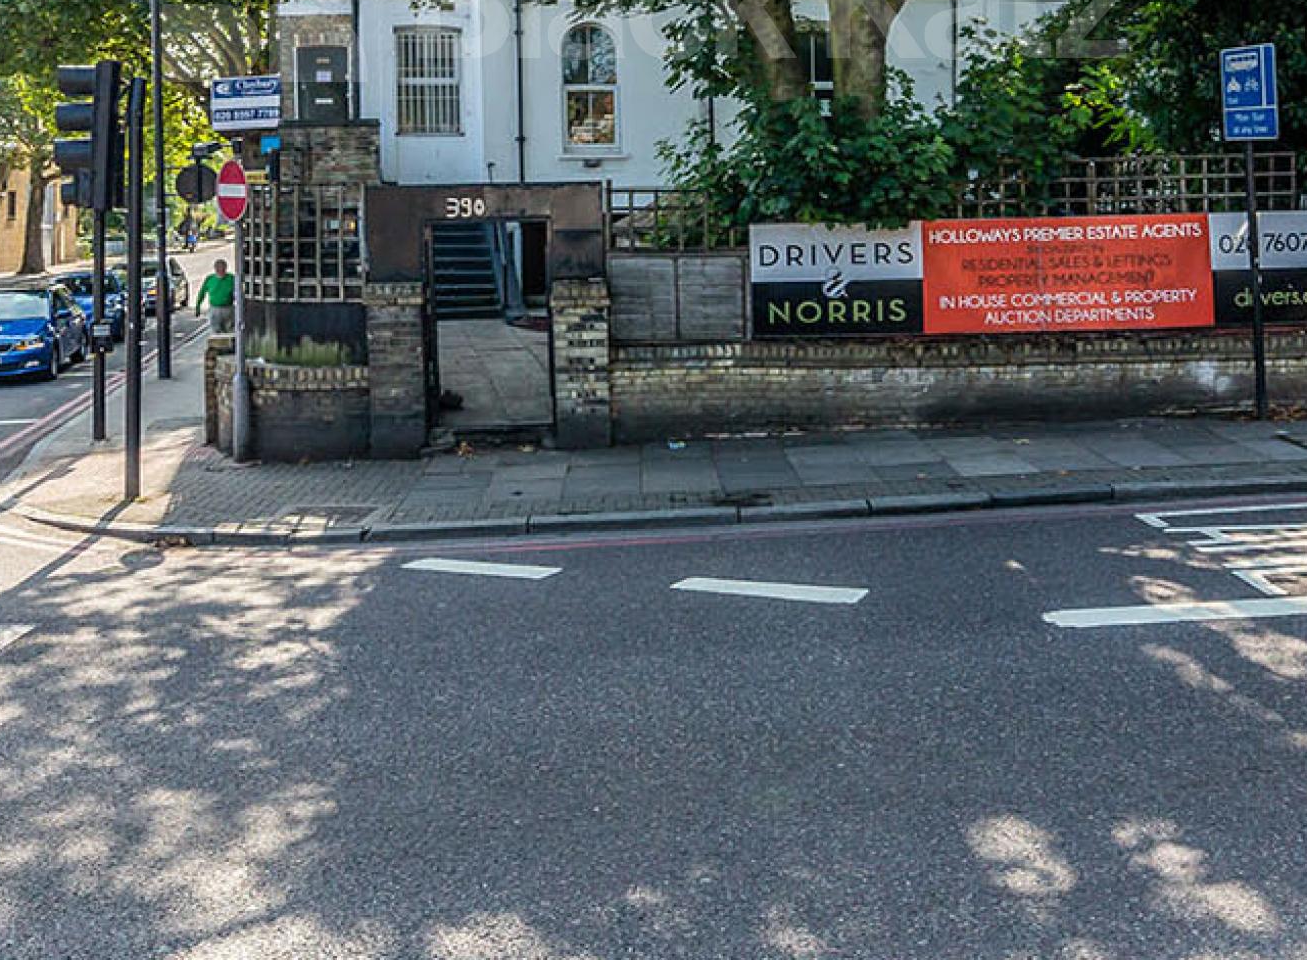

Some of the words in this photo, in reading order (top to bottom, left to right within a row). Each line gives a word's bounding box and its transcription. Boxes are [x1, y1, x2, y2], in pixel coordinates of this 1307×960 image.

[445, 197, 485, 218] 390
[928, 228, 1022, 244] HOLLOWAYS
[1023, 226, 1083, 242] PREMIER
[1086, 225, 1138, 240] ESTATE
[1141, 222, 1203, 238] AGENTS
[759, 242, 915, 266] DRIVERS
[962, 257, 1039, 271] RESIDENTIAL
[1047, 255, 1090, 268] SALES
[1108, 253, 1173, 267] LETTINGS
[978, 273, 1048, 287] PROPERTY
[1052, 271, 1156, 286] MANAGEMENT
[938, 295, 956, 310] IN
[958, 293, 1007, 309] HOUSE
[1010, 291, 1109, 308] COMMERCIAL
[1111, 289, 1122, 304] &
[1124, 287, 1198, 303] PROPERTY
[768, 299, 907, 324] NORRIS
[984, 309, 1052, 325] AUCTION
[1055, 306, 1156, 323] DEPARTMENTS
